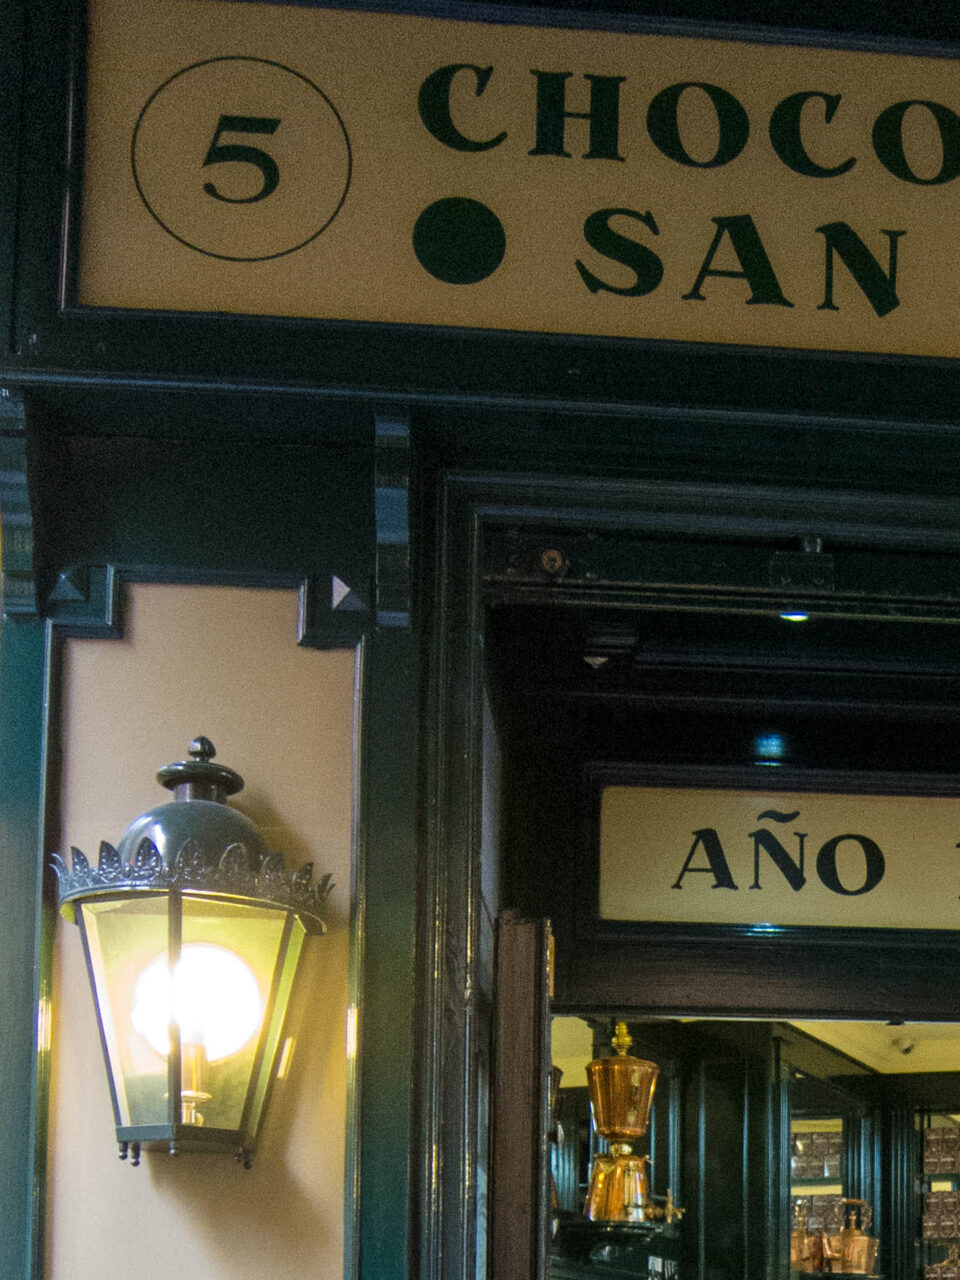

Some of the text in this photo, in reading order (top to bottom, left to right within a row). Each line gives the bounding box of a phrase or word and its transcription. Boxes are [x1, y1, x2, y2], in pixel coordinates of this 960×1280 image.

[202, 113, 282, 205] 5
[574, 207, 908, 319] SAN
[670, 808, 887, 897] AÑO
